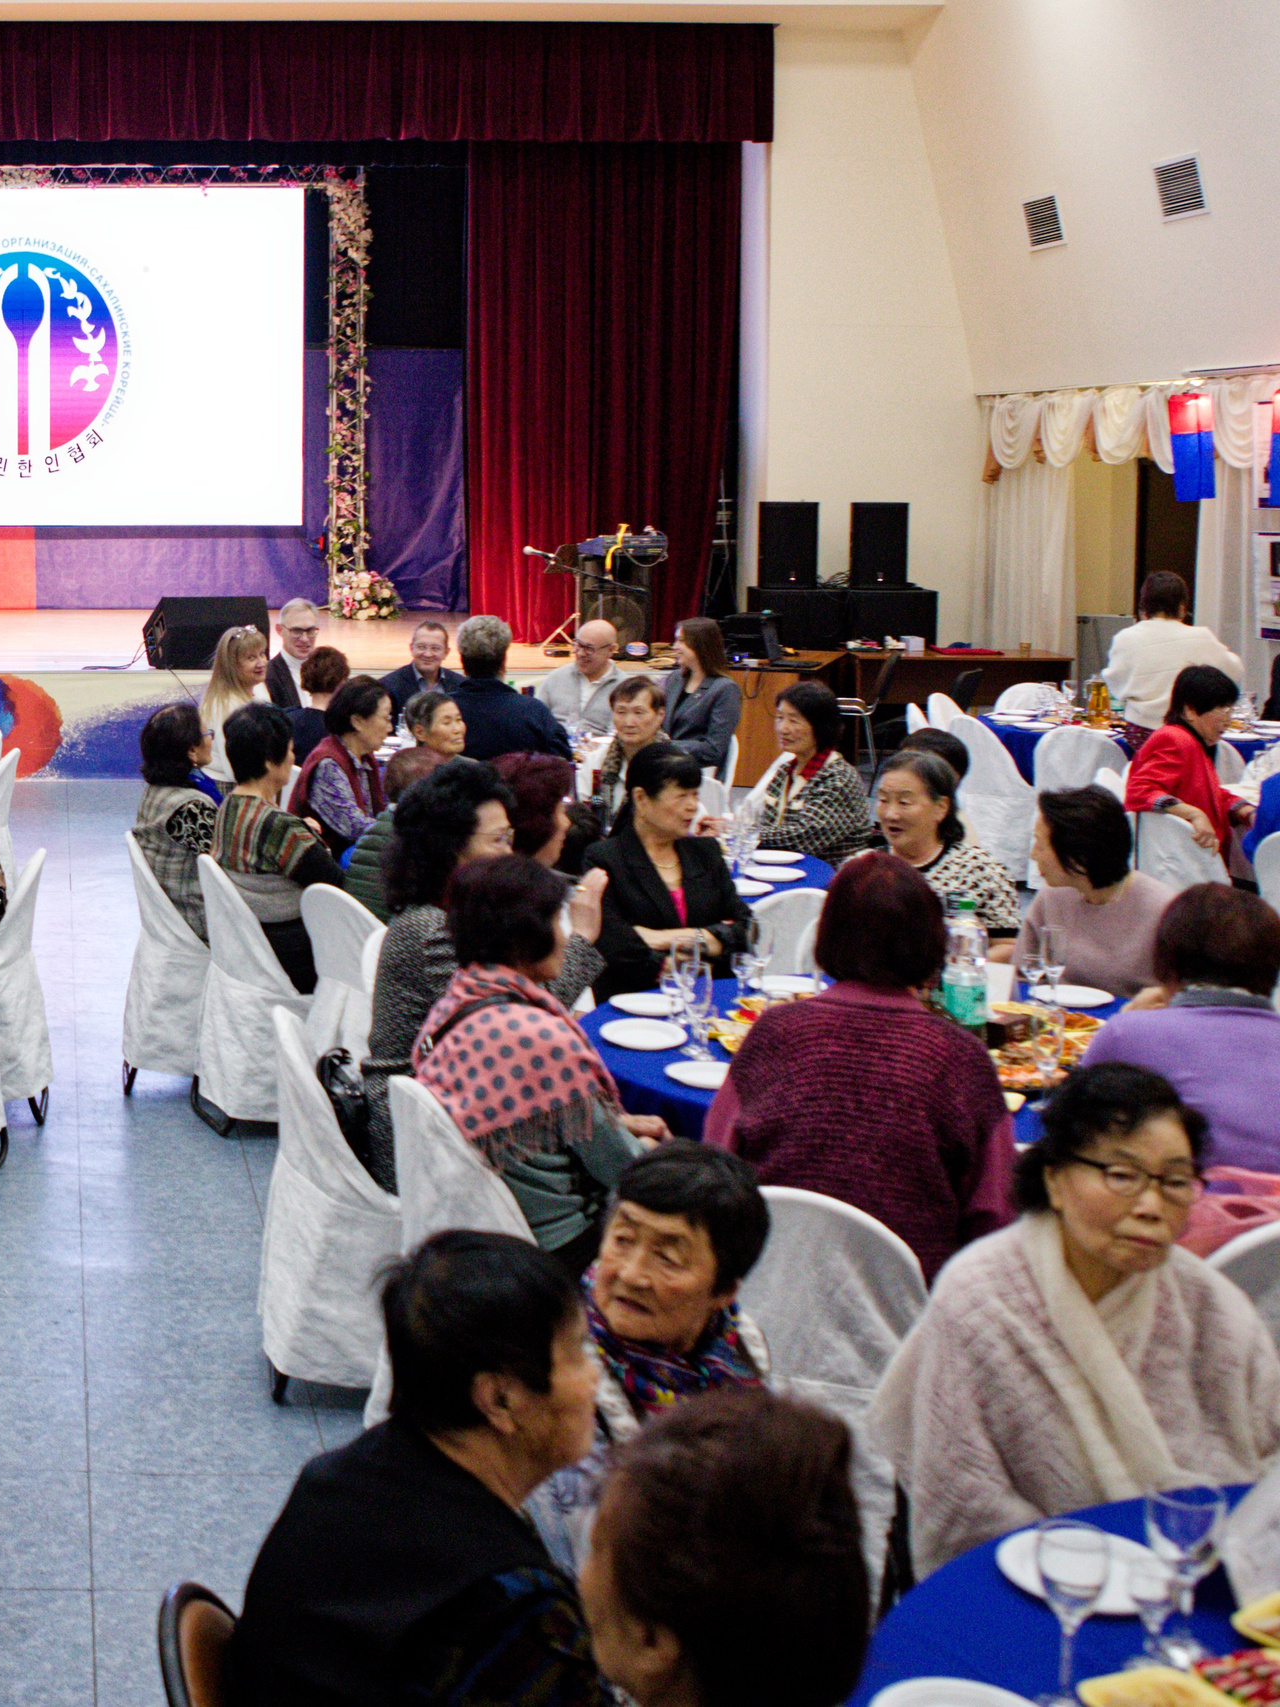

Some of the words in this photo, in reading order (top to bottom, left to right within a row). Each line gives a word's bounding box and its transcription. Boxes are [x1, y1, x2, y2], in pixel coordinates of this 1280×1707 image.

[1, 237, 89, 267] ОРГАНИЗАЦИЯ
[89, 267, 132, 356] САХАЛИНСКИЕ
[102, 361, 131, 425] КОРЕЙЦЫ
